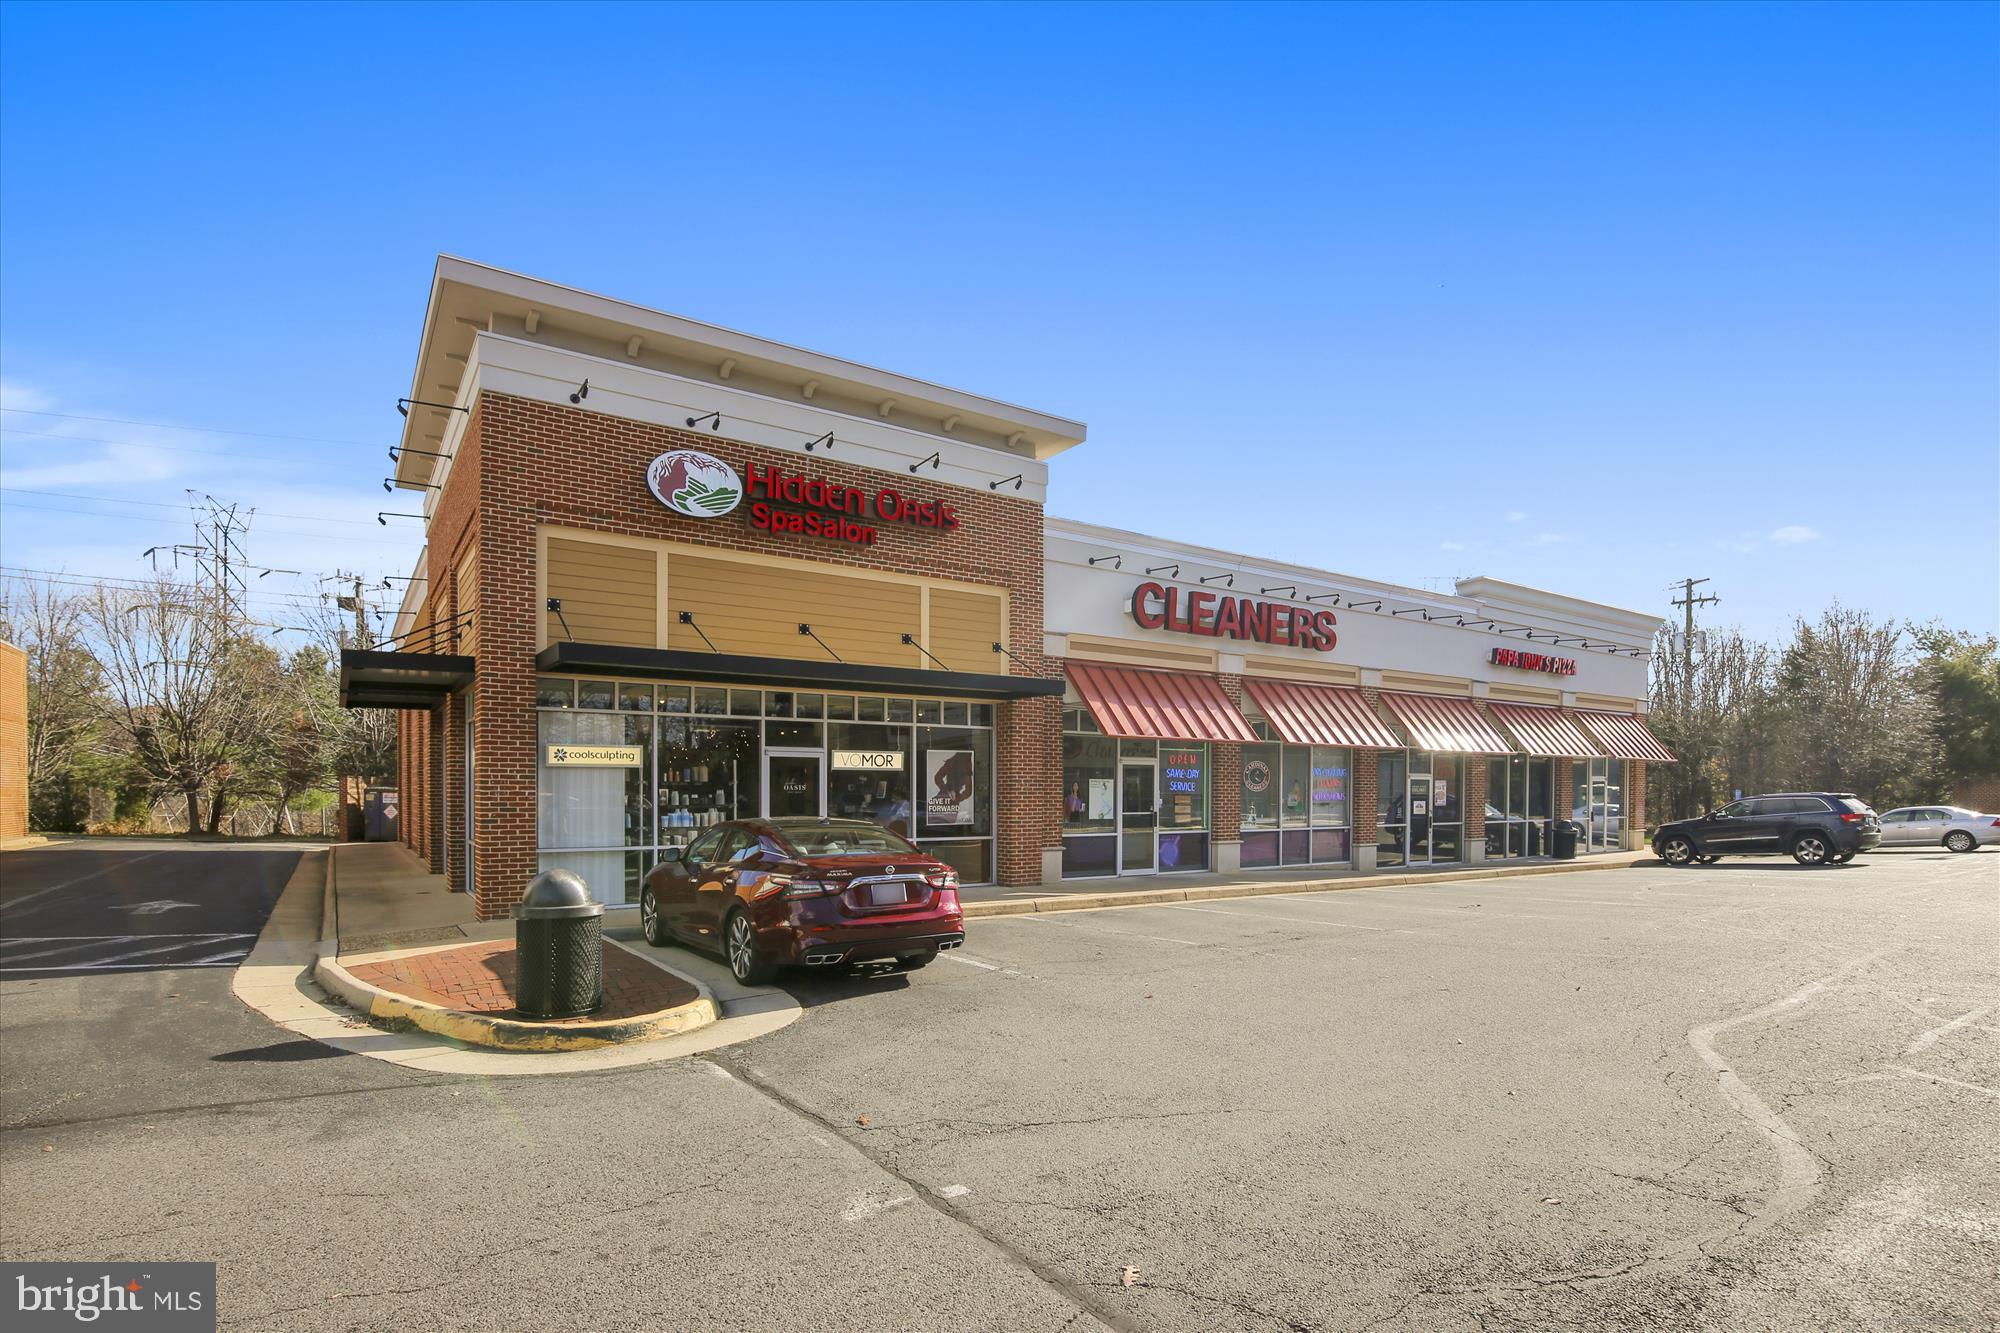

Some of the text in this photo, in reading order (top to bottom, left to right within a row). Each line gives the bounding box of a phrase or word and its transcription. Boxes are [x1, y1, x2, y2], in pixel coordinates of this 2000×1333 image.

[745, 461, 960, 531] Hidden Oasis
[751, 502, 877, 545] SpaSalon
[1132, 582, 1338, 652] CLEANERS
[1494, 648, 1519, 667] PAPA
[1553, 657, 1578, 675] PIZZA
[568, 750, 635, 761] coolsculpting
[840, 753, 894, 767] VOMOR
[1169, 754, 1198, 766] OPEN
[1169, 781, 1197, 792] SERVICE
